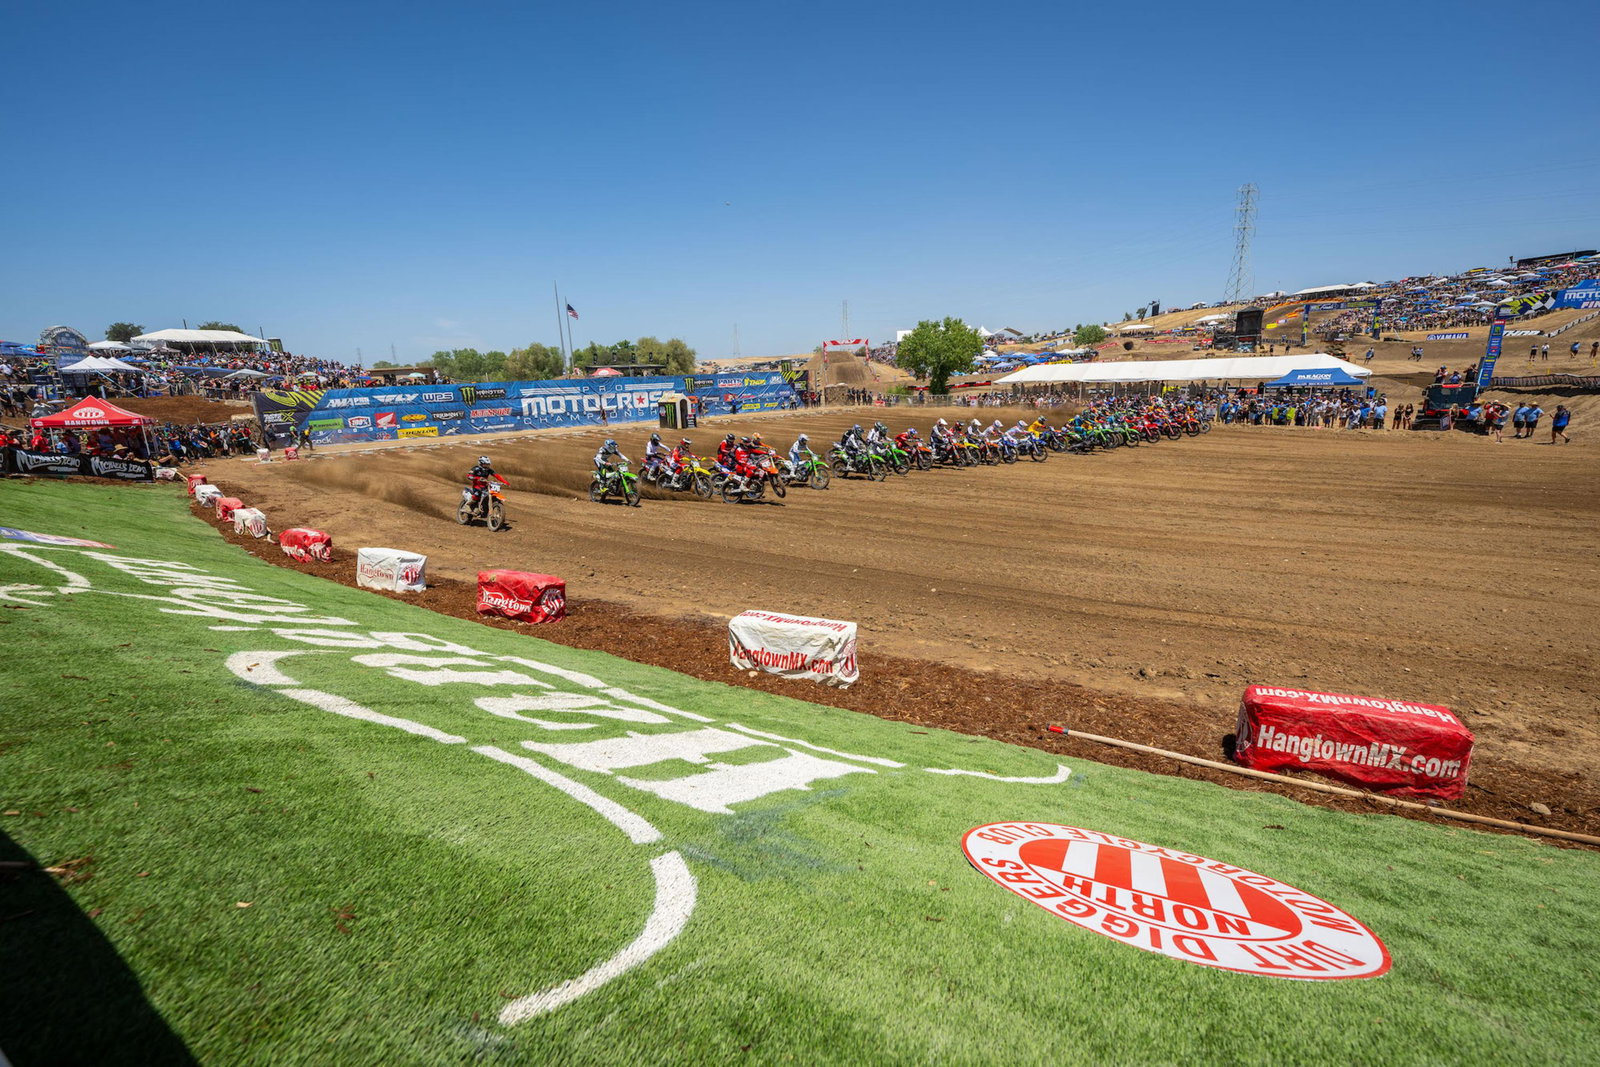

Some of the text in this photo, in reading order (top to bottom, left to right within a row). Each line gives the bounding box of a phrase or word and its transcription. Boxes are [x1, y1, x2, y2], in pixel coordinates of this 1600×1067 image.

[422, 392, 454, 403] WPS
[583, 384, 623, 393] PRO
[326, 398, 353, 408] AMA
[432, 411, 464, 419] TRIUMPH
[360, 563, 394, 580] Hangtown
[483, 591, 531, 612] Hangtown
[732, 642, 834, 674] HangtownMX.com
[1255, 687, 1457, 725] HangtownMX.com
[1257, 724, 1461, 778] HangtownMX.com
[977, 823, 1365, 936] MOTORCYCLE CLUB
[982, 856, 1367, 972] DIRT DIGGERS
[1063, 874, 1252, 937] NORTH
